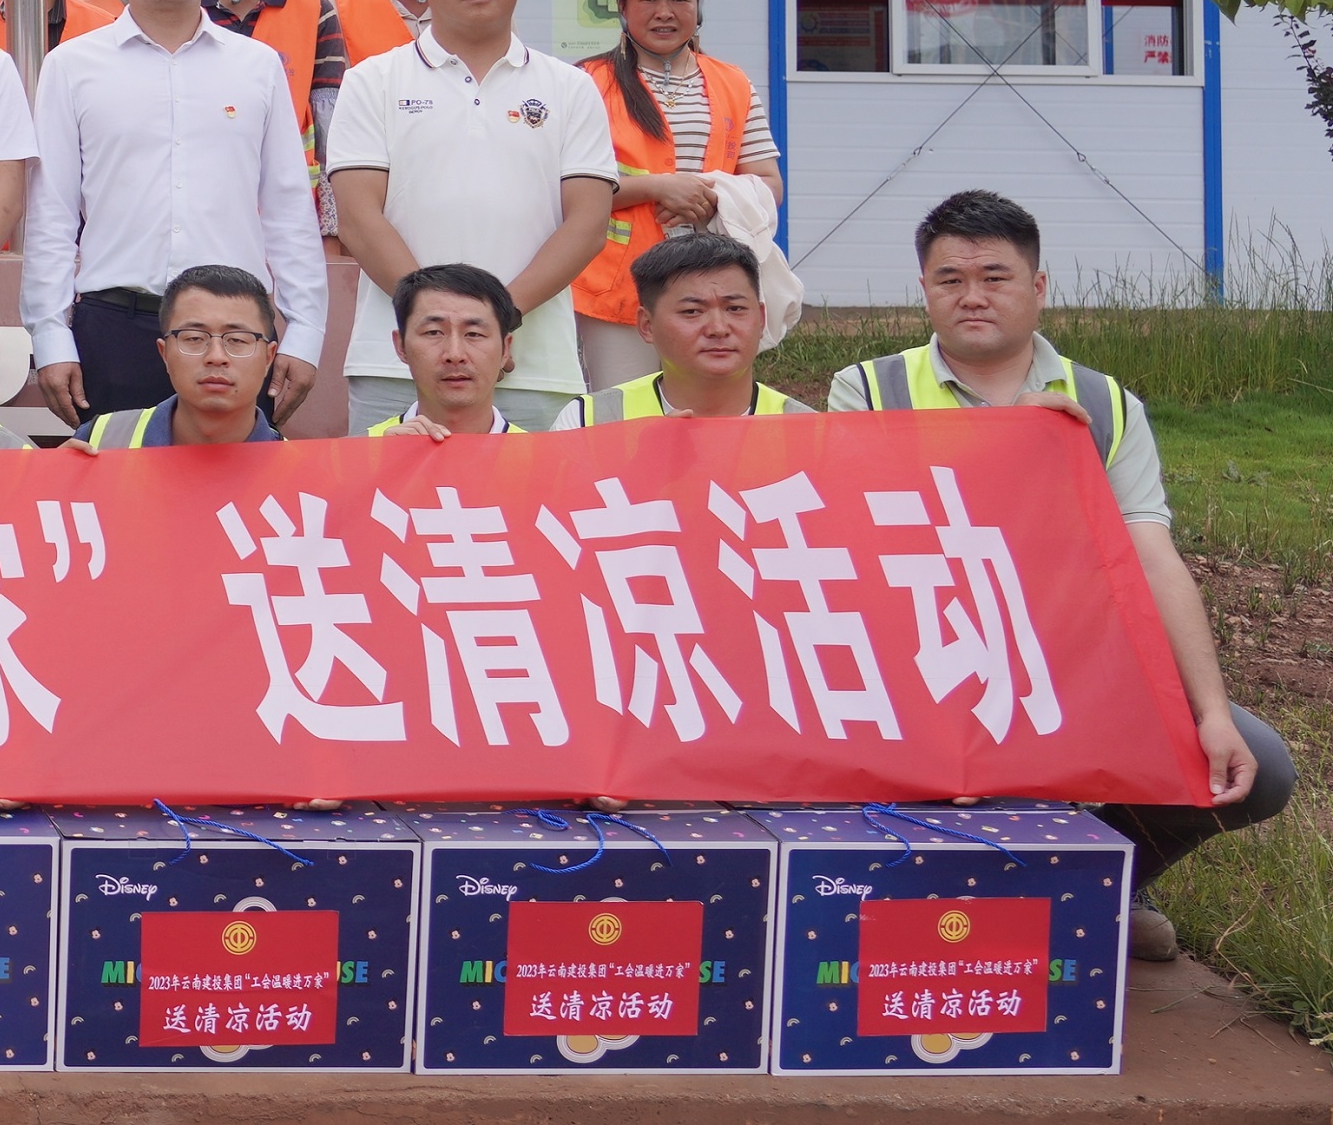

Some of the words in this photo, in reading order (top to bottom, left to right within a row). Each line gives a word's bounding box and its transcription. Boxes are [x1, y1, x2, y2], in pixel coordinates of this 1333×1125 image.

[1144, 35, 1169, 47] 消防
[1144, 50, 1170, 65] 严禁
[163, 1002, 313, 1035] 送清凉活动
[529, 990, 674, 1021] 送清凉活动
[882, 988, 1022, 1020] 送清凉活动
